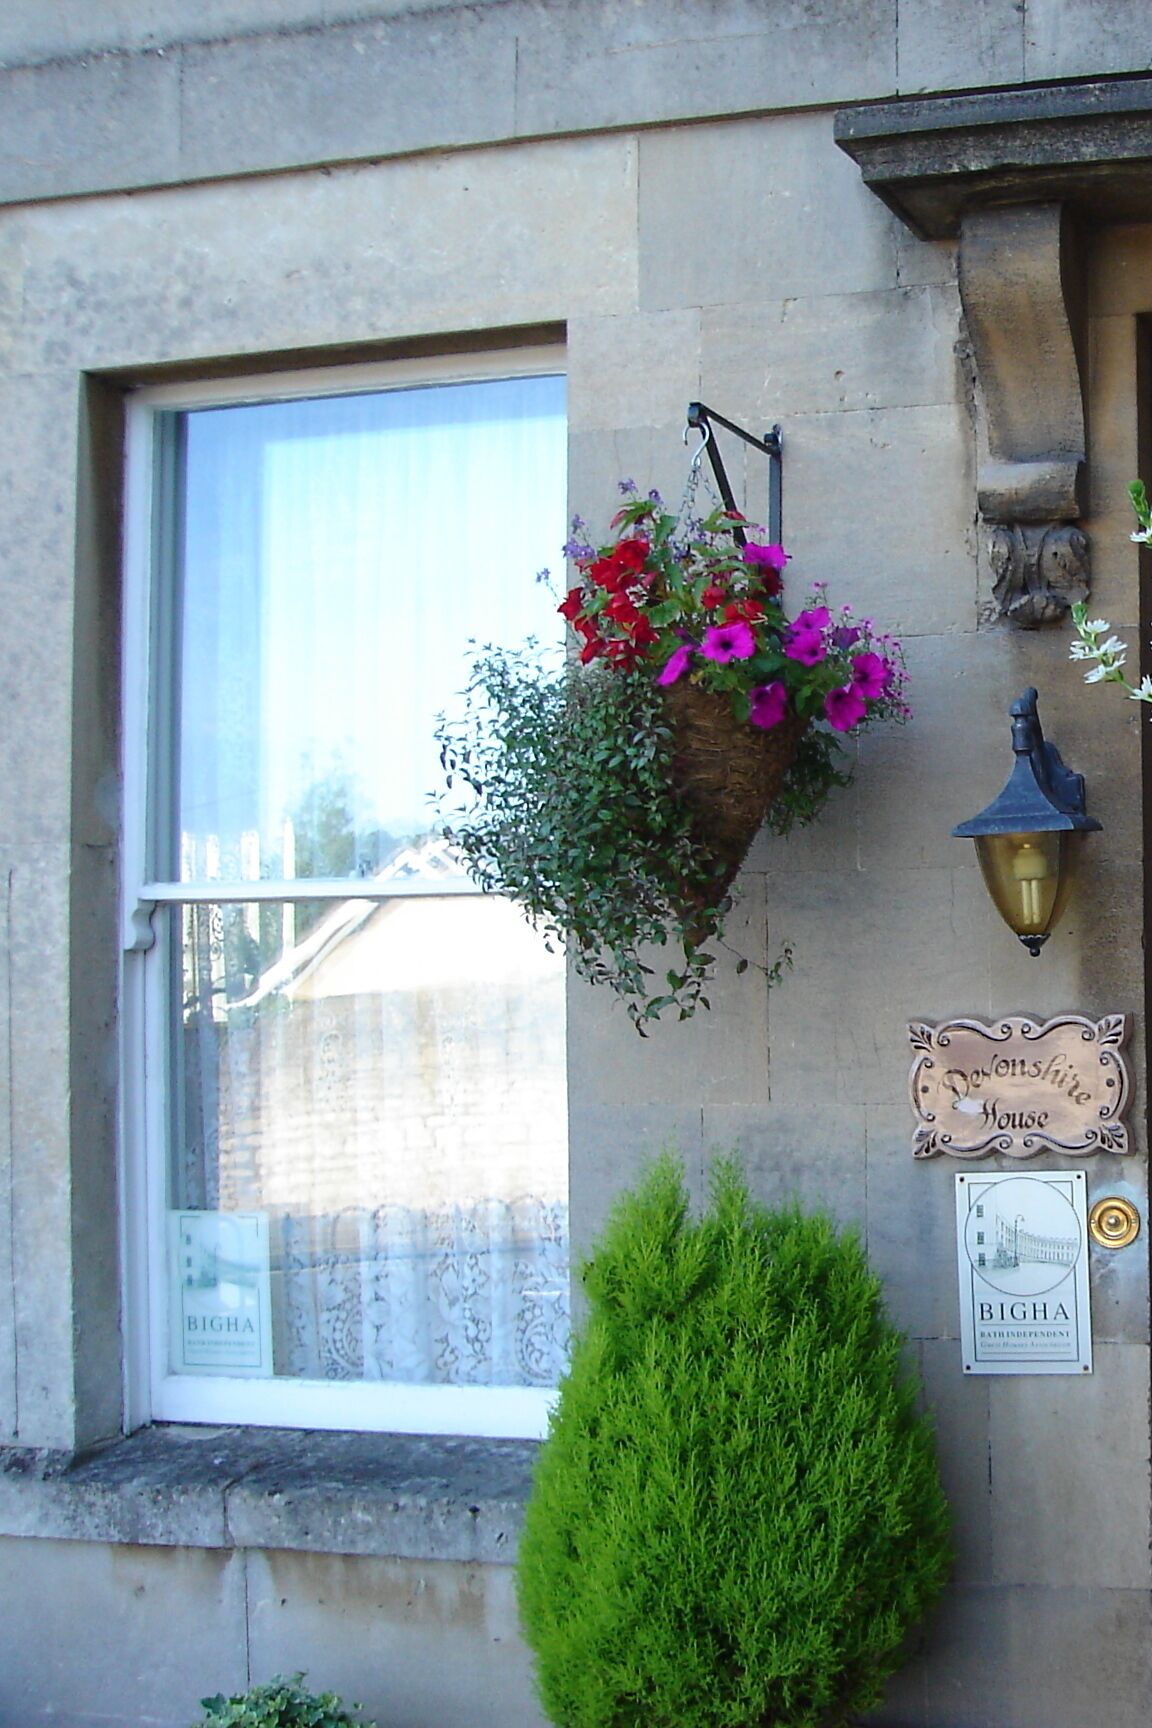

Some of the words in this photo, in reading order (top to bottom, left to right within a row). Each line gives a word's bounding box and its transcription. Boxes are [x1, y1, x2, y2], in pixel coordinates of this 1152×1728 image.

[938, 1053, 1092, 1105] Devonshire
[960, 1097, 1049, 1130] House
[980, 1302, 1070, 1321] BIGHA
[187, 1315, 254, 1333] BIGHA
[980, 1330, 1004, 1339] BATH
[1006, 1330, 1070, 1338] INDEPENDENT
